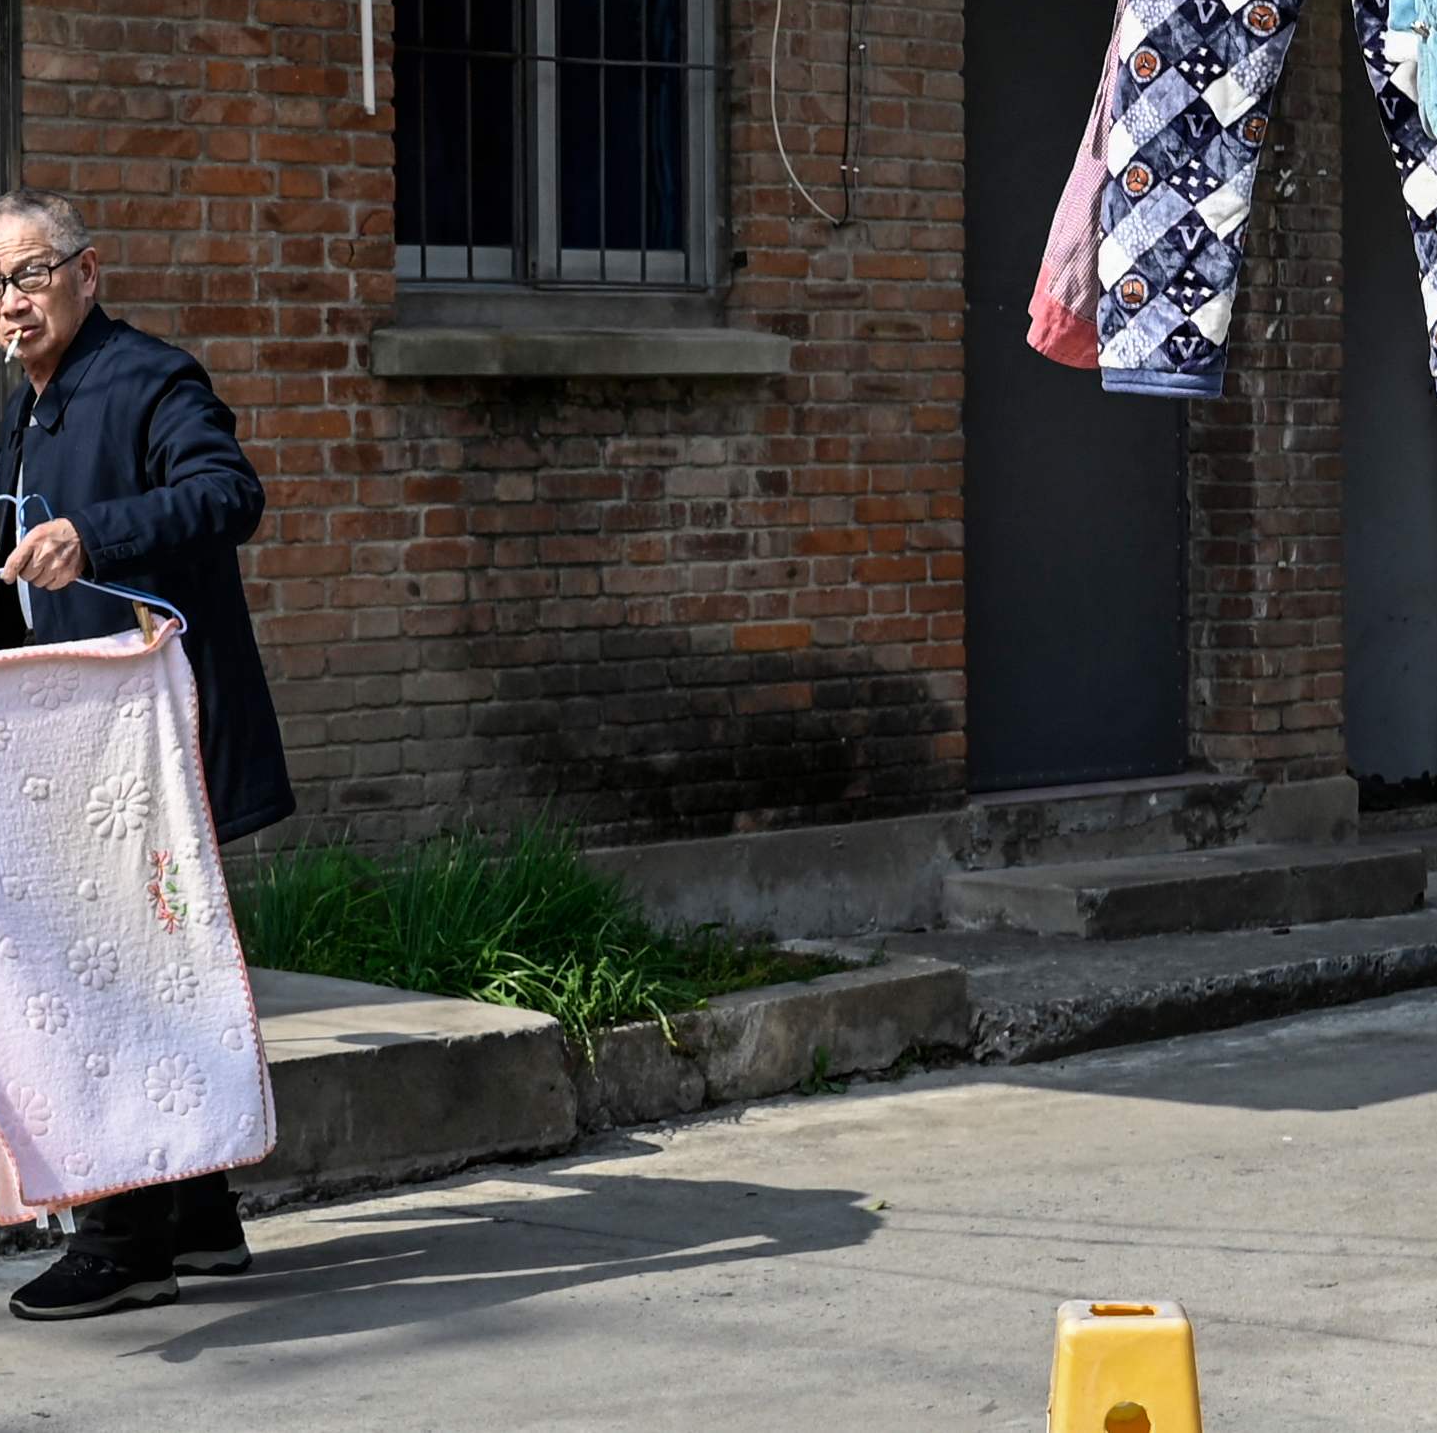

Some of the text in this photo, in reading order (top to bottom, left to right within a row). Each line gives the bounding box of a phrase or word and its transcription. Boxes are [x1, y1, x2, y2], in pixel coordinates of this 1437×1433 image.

[1379, 97, 1400, 119] V
[1184, 113, 1212, 138] V
[1177, 225, 1205, 250] V
[1172, 335, 1201, 359] V
